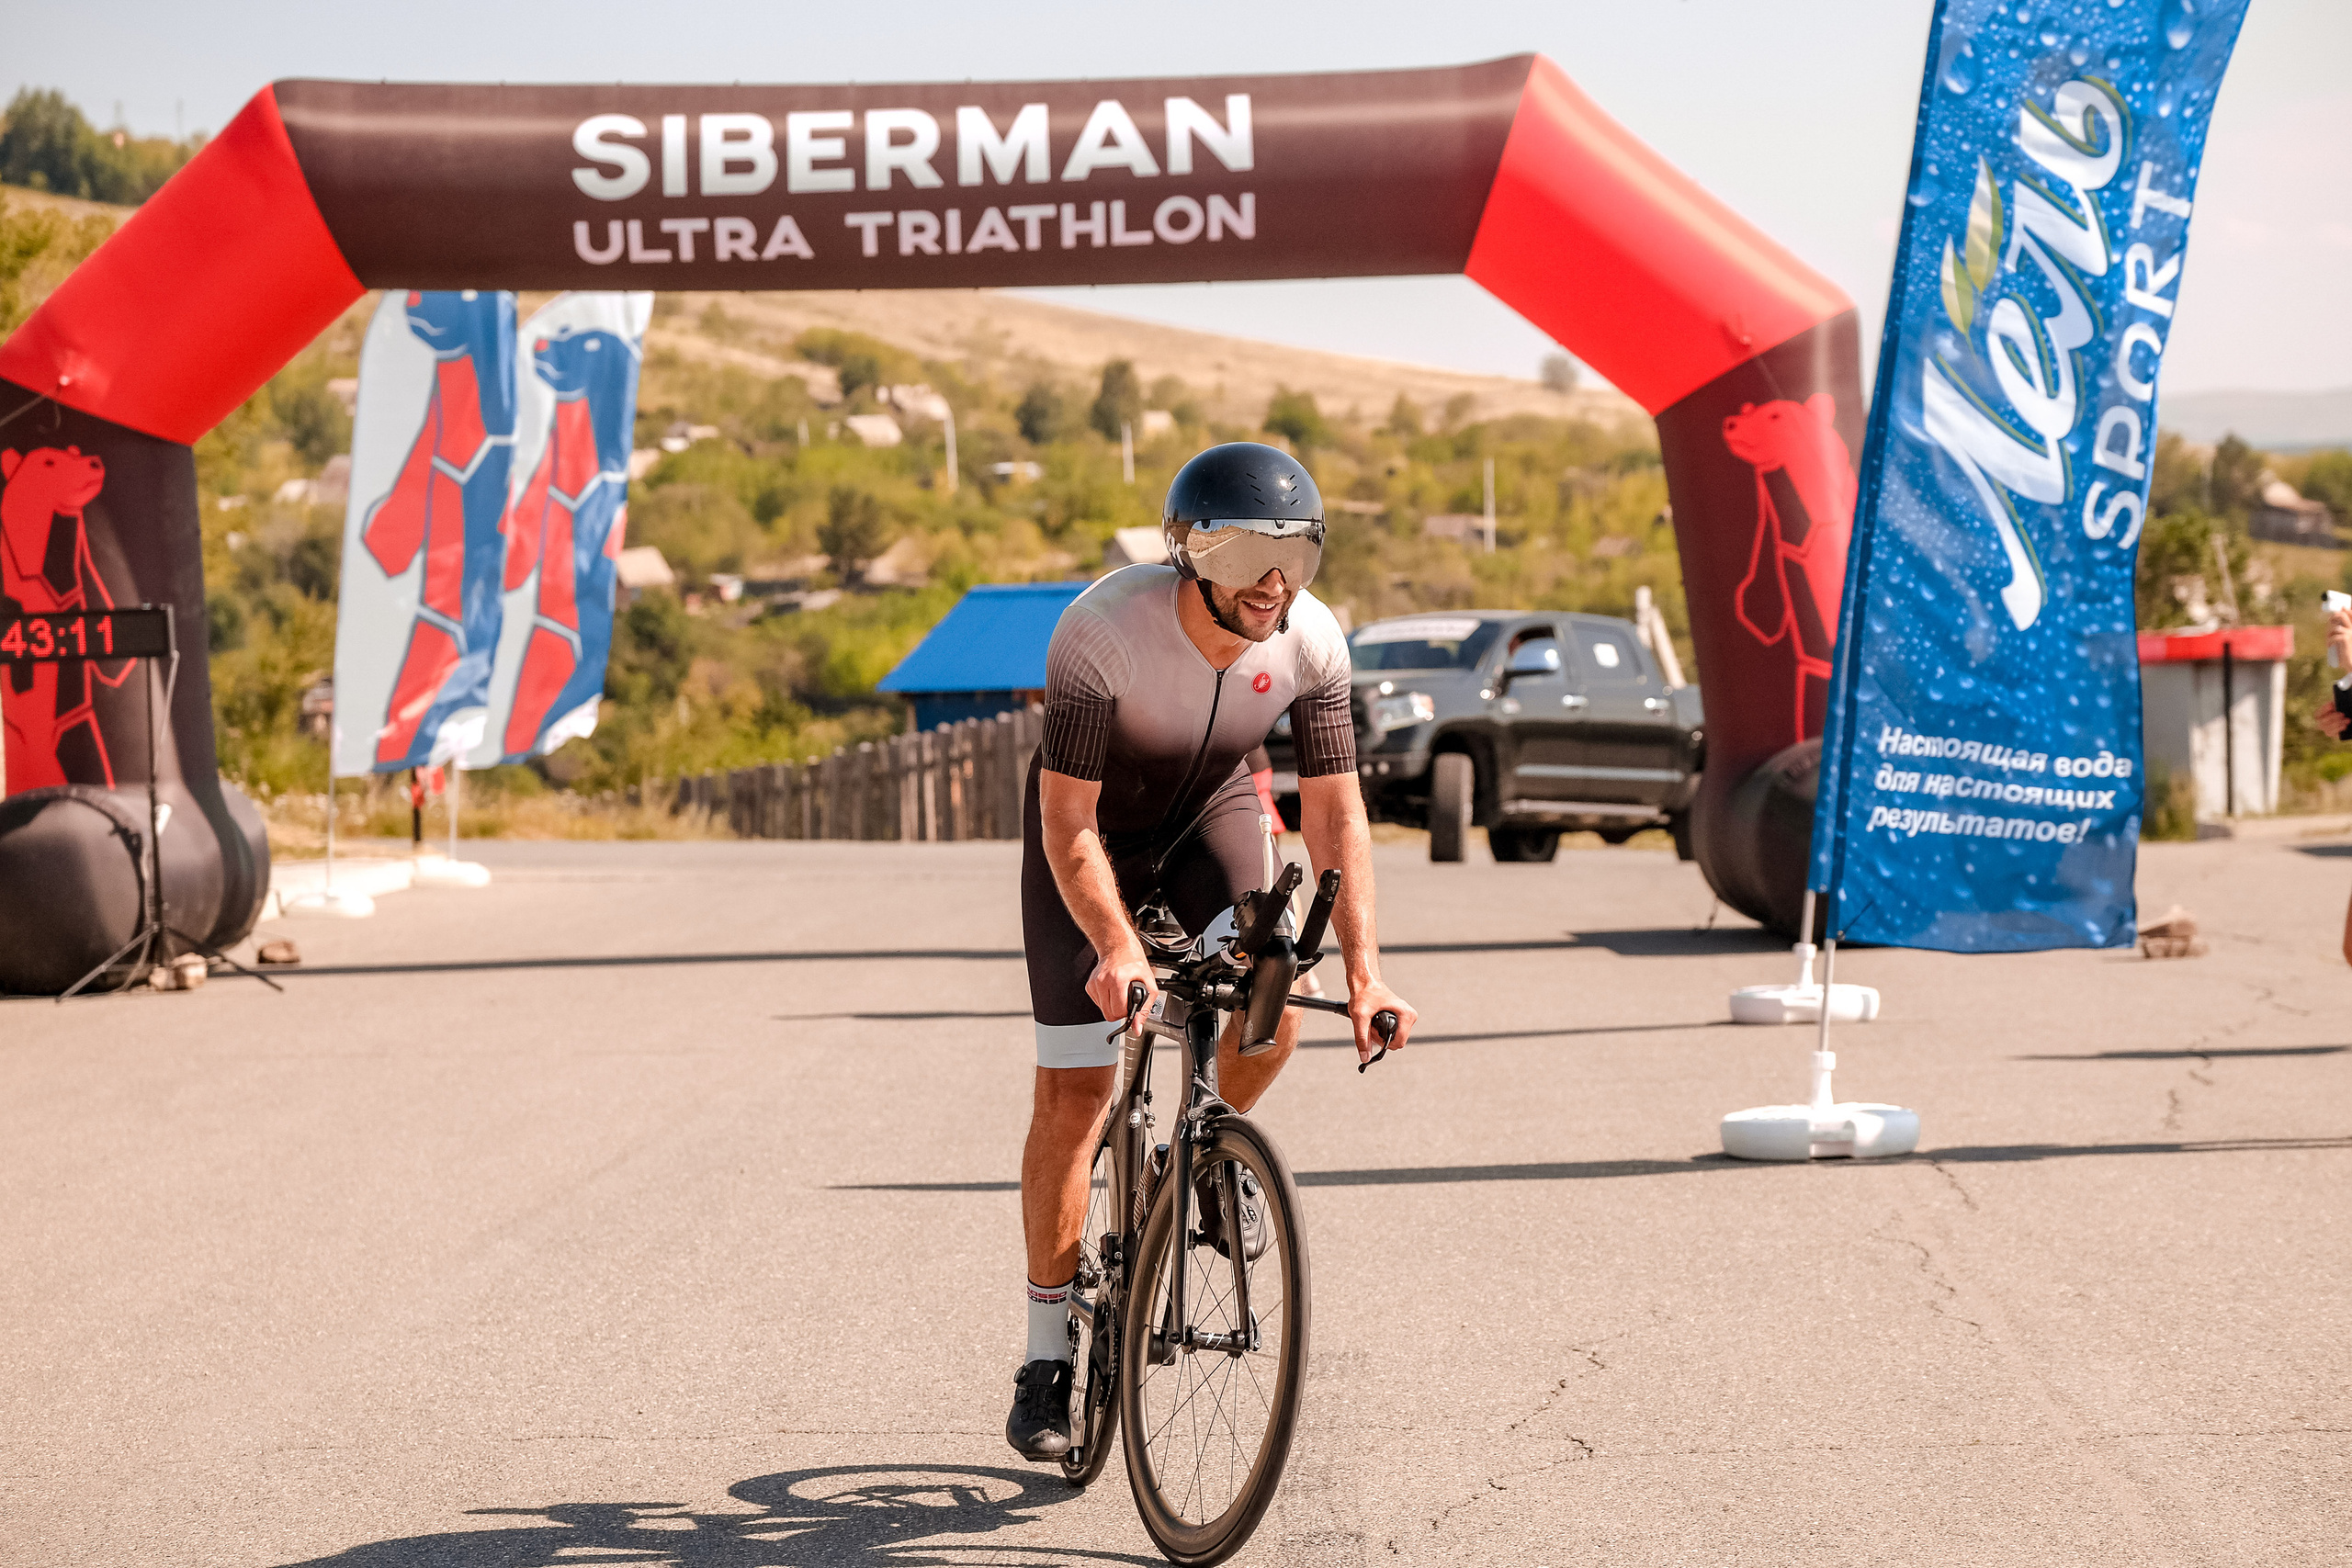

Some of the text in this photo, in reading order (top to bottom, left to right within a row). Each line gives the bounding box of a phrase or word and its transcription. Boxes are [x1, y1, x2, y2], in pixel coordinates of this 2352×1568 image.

[571, 94, 1254, 201] SIBERMAN
[572, 192, 1256, 265] ULTRA TRIATHLON
[2083, 160, 2192, 550] SPORT
[0, 615, 114, 658] 43:11
[1877, 726, 2133, 779] Настоящая вода
[1873, 762, 2117, 812] для настоящих
[1866, 805, 2092, 845] результатов!
